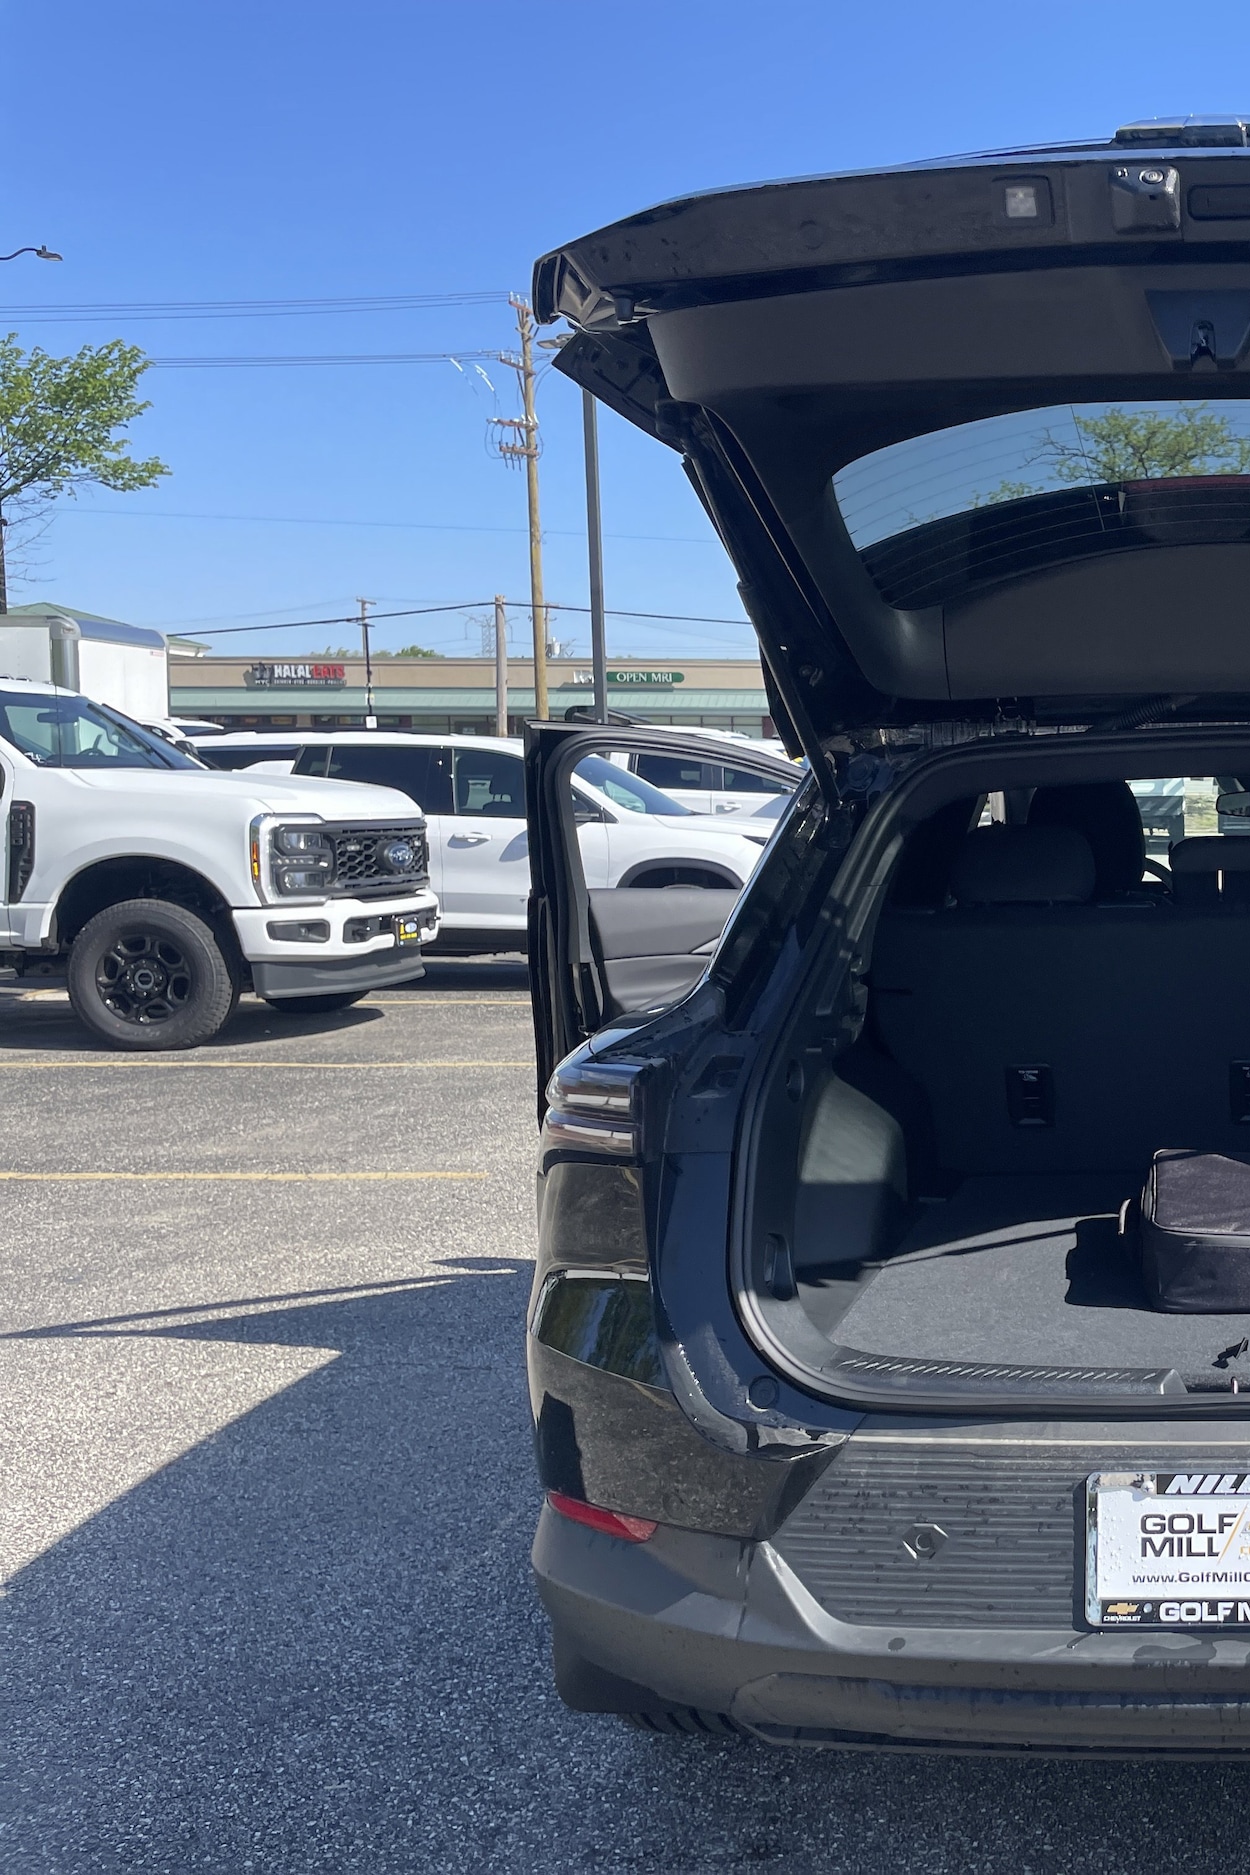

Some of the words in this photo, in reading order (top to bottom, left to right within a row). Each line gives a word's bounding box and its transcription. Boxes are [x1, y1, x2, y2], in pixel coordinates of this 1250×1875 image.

[274, 664, 311, 678] HALAL
[313, 664, 345, 678] EATS
[616, 672, 647, 682] OPEN
[652, 672, 673, 682] MRI
[1140, 1513, 1239, 1534] GOLF
[1140, 1537, 1221, 1557] MILL
[1159, 1601, 1235, 1622] GOLF
